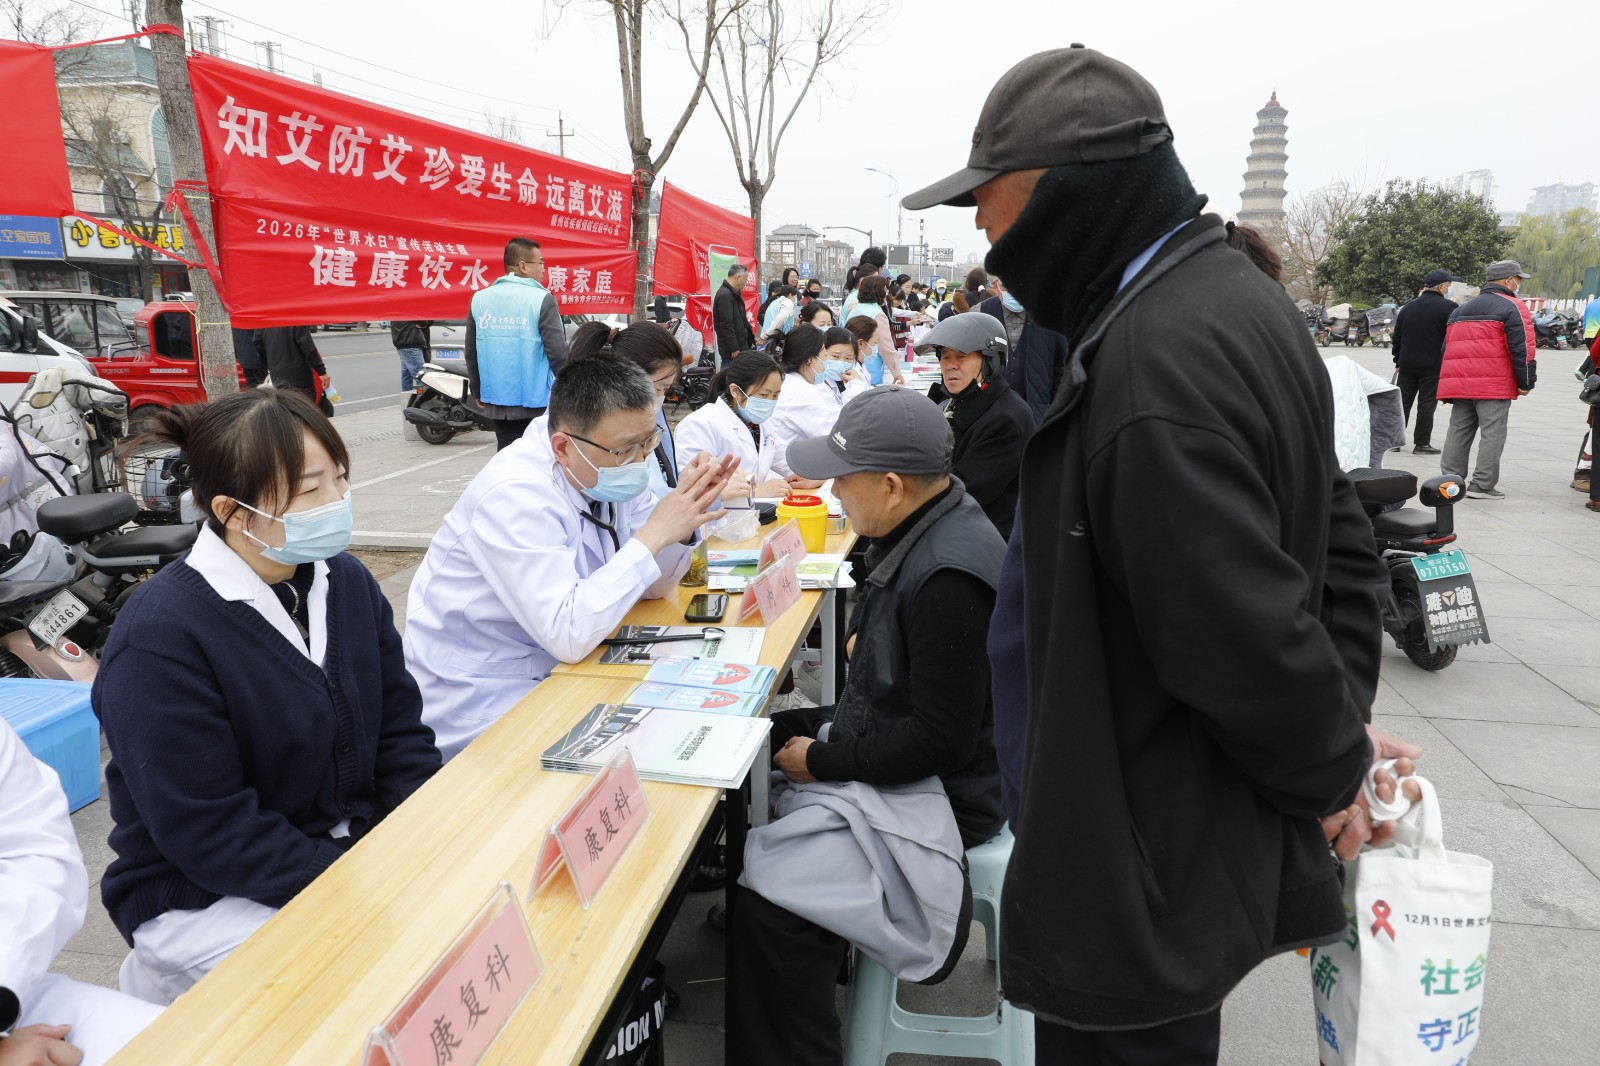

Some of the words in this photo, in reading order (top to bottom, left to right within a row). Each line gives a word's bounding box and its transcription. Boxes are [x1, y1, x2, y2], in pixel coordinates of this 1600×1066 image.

[218, 95, 413, 185] 知艾防艾
[419, 146, 539, 206] 珍爱生命
[545, 173, 623, 223] 远离艾滋
[309, 244, 490, 291] 健康饮水
[541, 264, 612, 295] 康家庭
[834, 431, 847, 447] Jeep
[1420, 561, 1466, 578] 0770150
[43, 602, 81, 641] 1044861
[584, 786, 632, 866] 康复科
[1420, 953, 1487, 997] 社会
[429, 943, 512, 1066] 康复科
[1417, 1005, 1479, 1052] 守正
